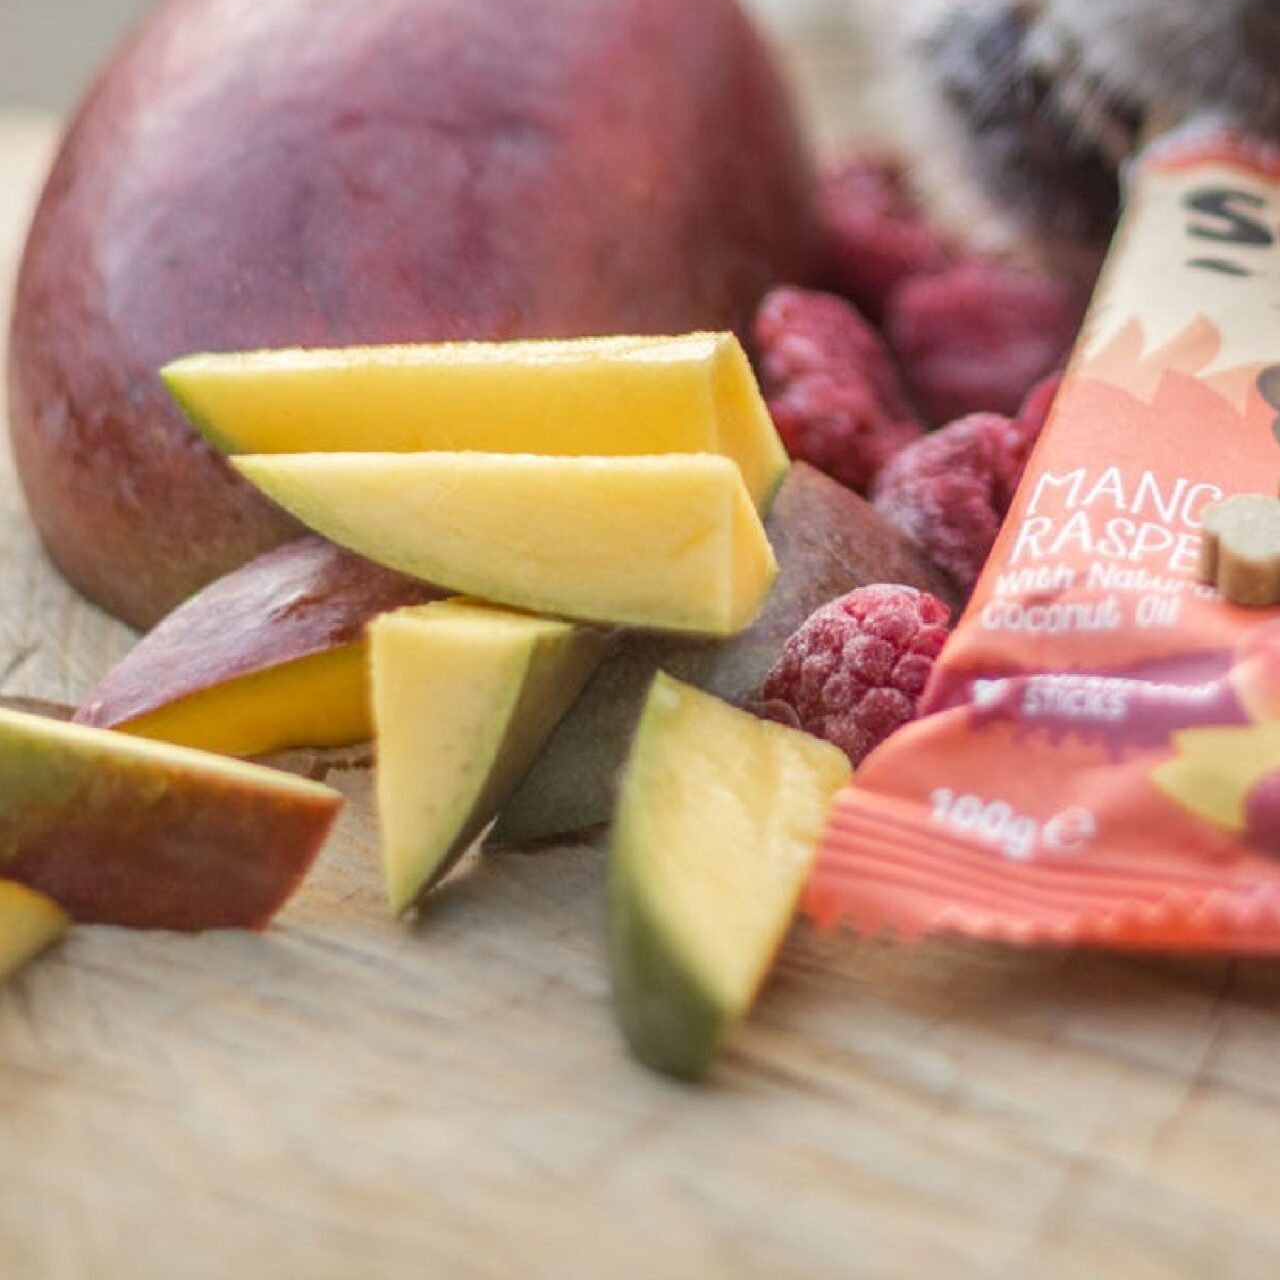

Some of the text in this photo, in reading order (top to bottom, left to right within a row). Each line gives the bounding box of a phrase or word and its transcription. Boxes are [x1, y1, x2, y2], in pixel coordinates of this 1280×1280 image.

[980, 593, 1182, 634] Coconut Oil
[931, 787, 1036, 860] 100g
